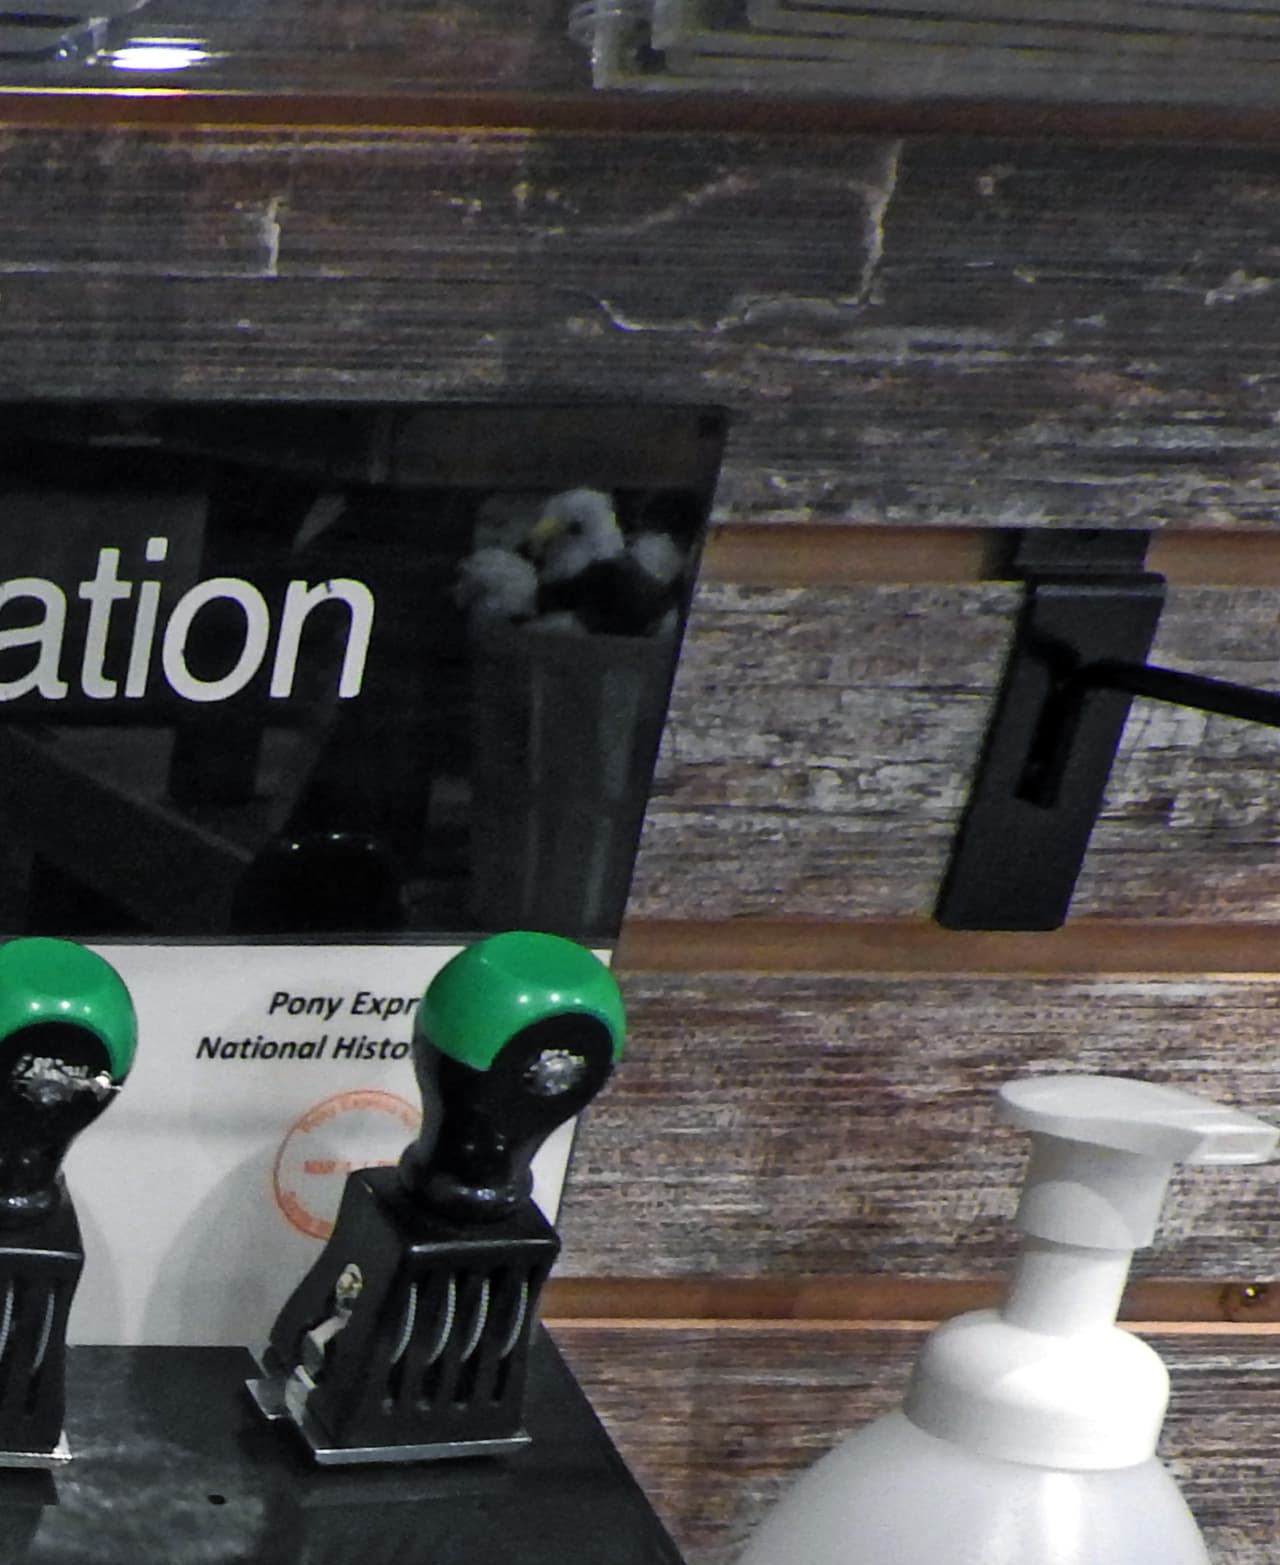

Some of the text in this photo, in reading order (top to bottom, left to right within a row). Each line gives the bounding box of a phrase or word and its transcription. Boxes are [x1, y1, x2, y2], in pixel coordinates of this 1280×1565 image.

[268, 991, 419, 1020] Pony Expr
[196, 1035, 410, 1060] National Histo
